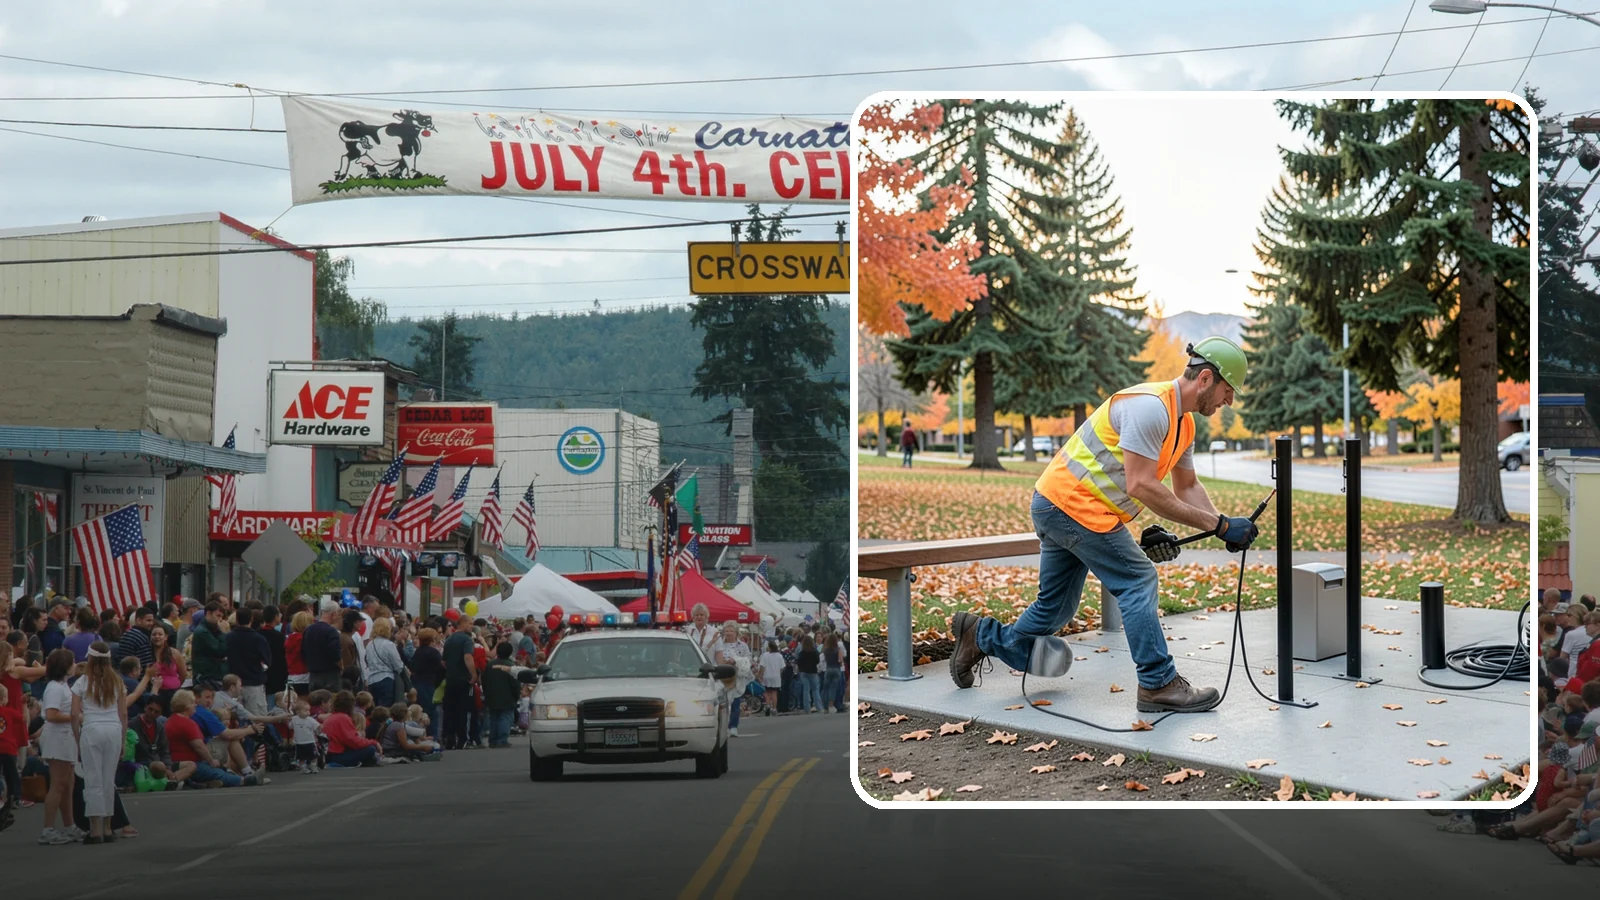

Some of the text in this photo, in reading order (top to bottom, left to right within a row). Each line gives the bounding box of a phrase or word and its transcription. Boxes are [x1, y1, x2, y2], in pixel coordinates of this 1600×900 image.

[481, 141, 604, 192] JULY
[632, 150, 748, 198] 4th.
[696, 254, 850, 280] CROSSWA
[283, 380, 373, 420] ACE
[406, 409, 485, 421] CEDAR LOG
[283, 421, 370, 436] Hardware
[83, 485, 155, 495] St. Vincent de Paul
[688, 526, 741, 535] CRNATION
[699, 535, 730, 543] GLASS
